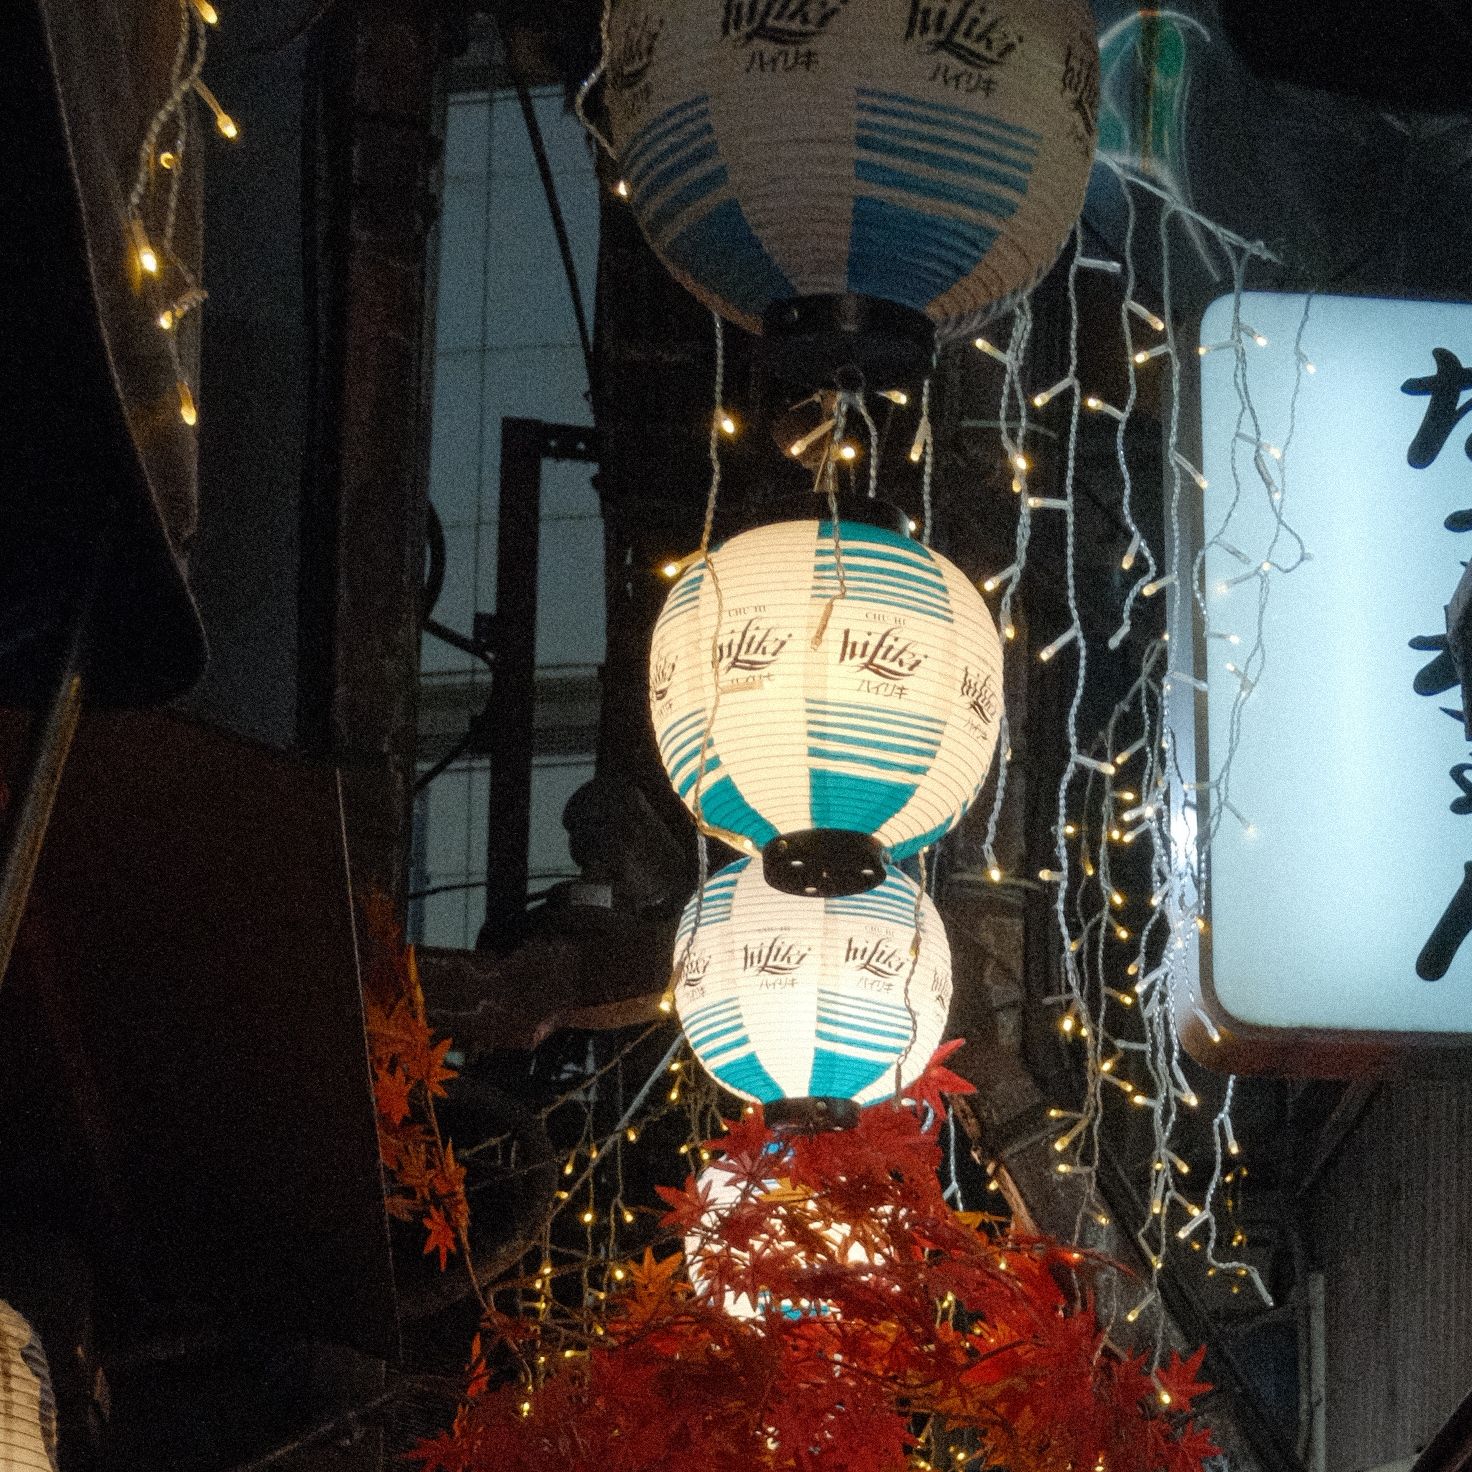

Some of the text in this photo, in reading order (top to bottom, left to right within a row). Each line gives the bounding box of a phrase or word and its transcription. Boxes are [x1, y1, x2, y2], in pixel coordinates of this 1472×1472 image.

[744, 48, 819, 75] ハイリキ
[929, 63, 998, 97] ハイリキ
[856, 679, 910, 700] ハイリキ
